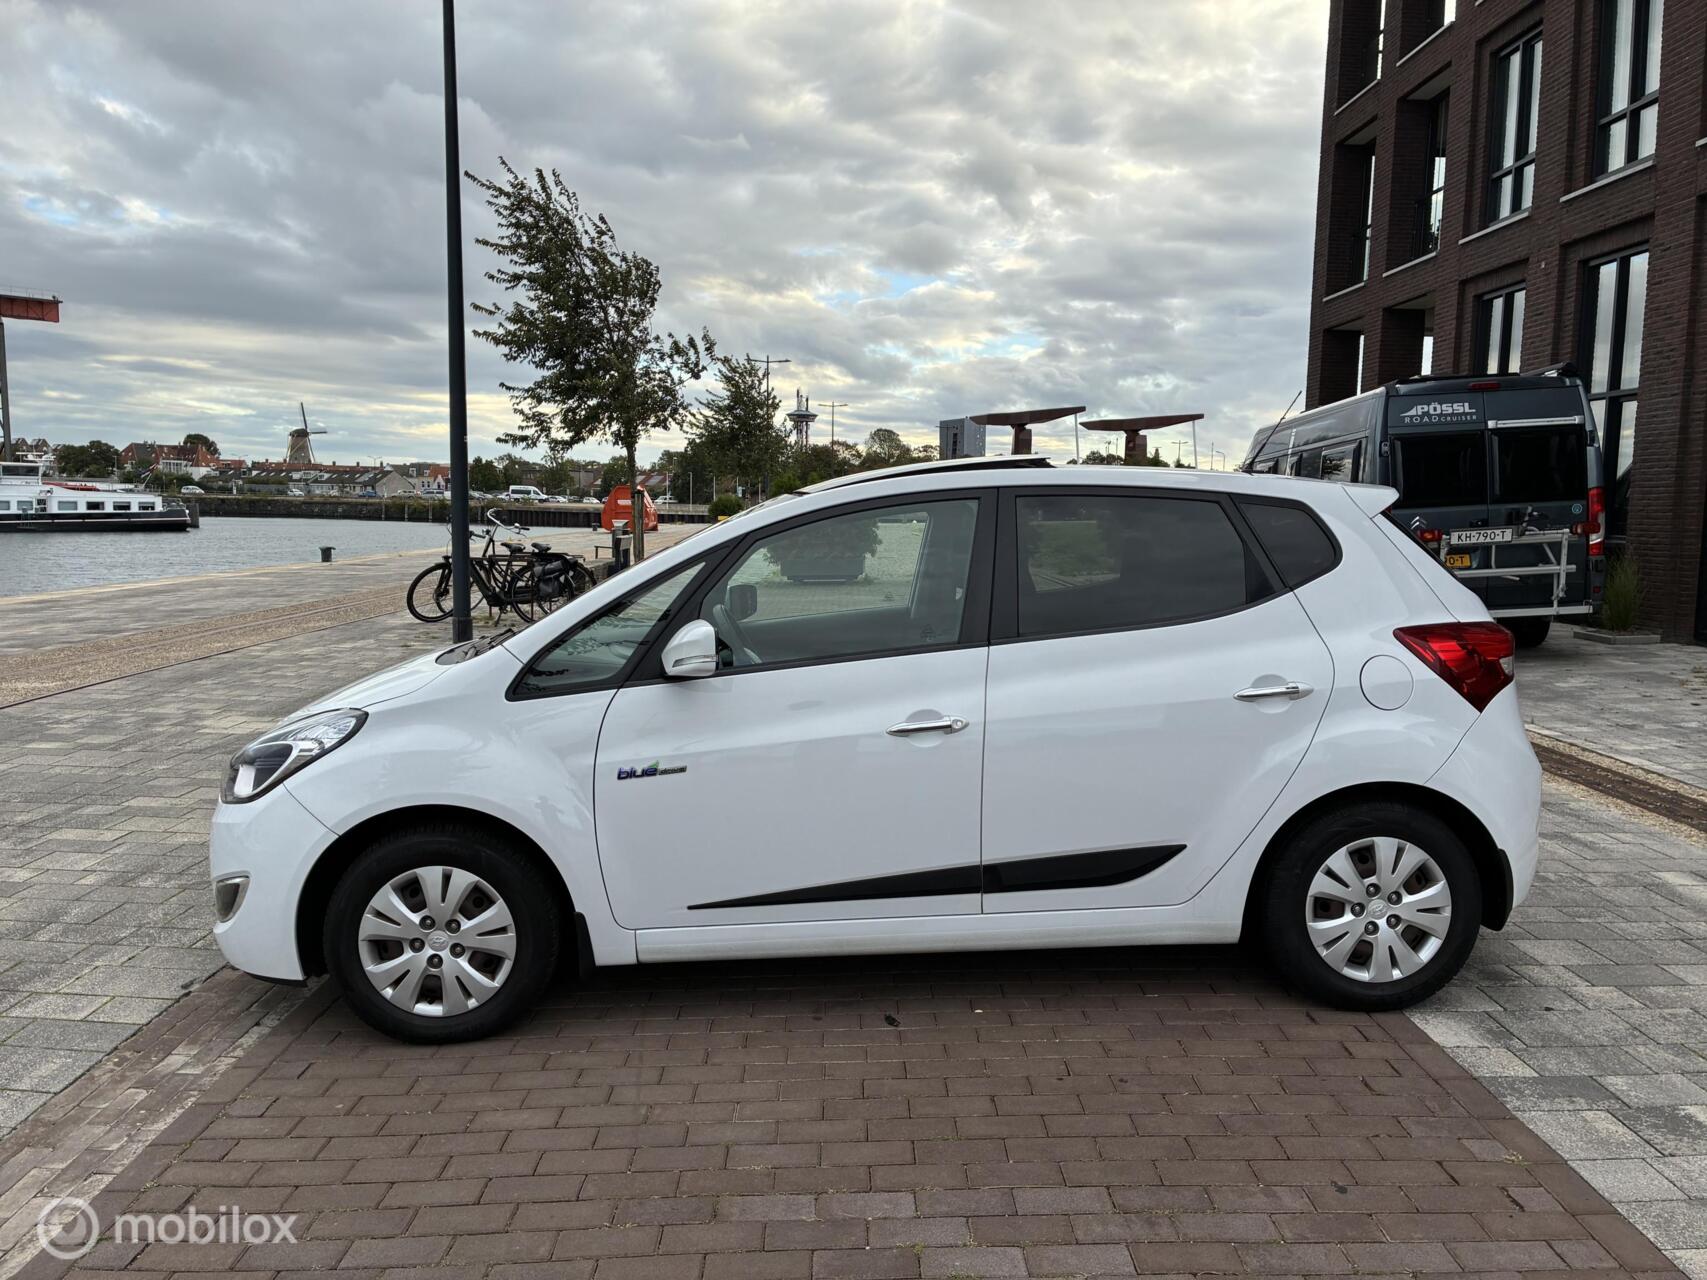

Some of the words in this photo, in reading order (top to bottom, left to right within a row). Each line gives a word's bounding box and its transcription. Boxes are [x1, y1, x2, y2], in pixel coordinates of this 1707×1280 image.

[1416, 402, 1476, 415] PÖSSL
[1457, 531, 1507, 542] KH-790-T
[617, 767, 658, 780] blue
